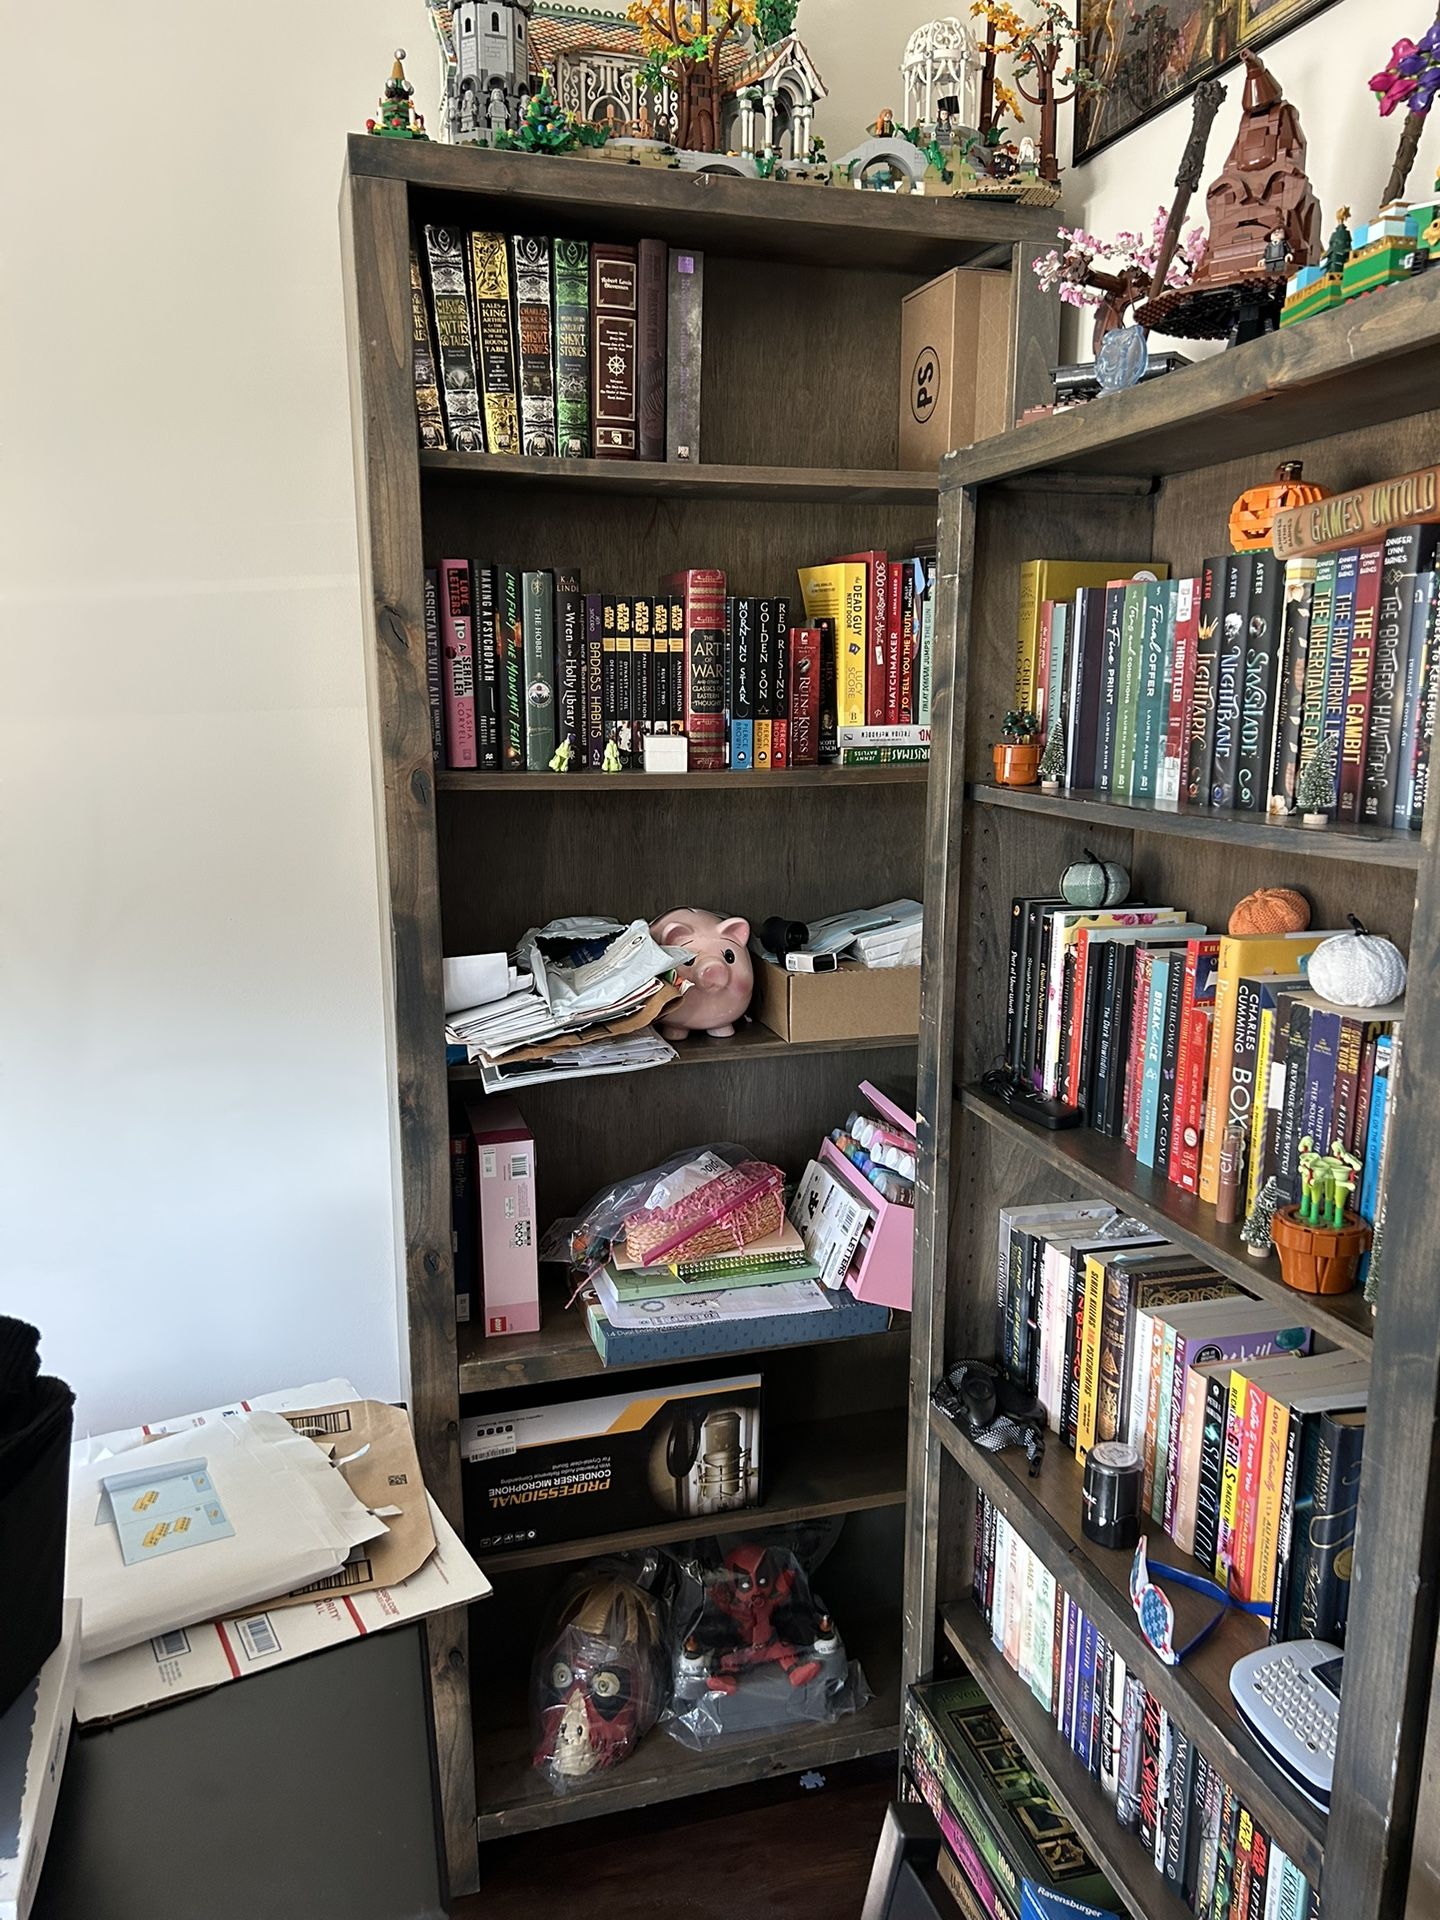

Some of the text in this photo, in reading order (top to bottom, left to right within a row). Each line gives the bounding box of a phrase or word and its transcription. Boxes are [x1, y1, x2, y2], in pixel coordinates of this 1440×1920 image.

[482, 309, 506, 317] KING
[522, 331, 548, 343] SHORT
[522, 345, 549, 354] STORIES
[560, 334, 585, 346] SHORT
[560, 347, 586, 357] STORIES
[917, 362, 933, 408] PS
[1311, 494, 1362, 543] GAMES
[1370, 472, 1435, 526] UNTOLD
[448, 569, 460, 615] LETTERS
[460, 579, 469, 605] LOVE
[482, 569, 492, 606] MAKING
[1204, 568, 1213, 600] ASTER
[1229, 567, 1238, 598] ASTER
[1254, 562, 1264, 594] ASTER
[852, 585, 862, 636] DEAD GUY
[903, 611, 911, 637] TRUTH
[483, 621, 494, 681] PSYCHOPATH
[694, 642, 722, 657] ART
[739, 601, 751, 704] MORNING STAR
[759, 602, 770, 699] GOLDEN SON
[1106, 626, 1120, 664] Fine
[1147, 604, 1164, 697] Final OFFER
[1326, 592, 1353, 714] THE HAWTHORNE
[452, 660, 464, 696] KILLER
[463, 656, 472, 693] SERIAL
[692, 663, 723, 678] WAR
[776, 640, 785, 699] RISING
[889, 633, 897, 708] MATCHMAKER
[1106, 669, 1115, 705] PRINT
[1172, 638, 1187, 703] THROTTLED
[1343, 607, 1374, 765] THE FINAL GAMBIT
[590, 642, 602, 738] BADASS HABITS
[902, 698, 909, 709] TO
[1215, 646, 1240, 757] NIGHTBANE
[457, 702, 465, 745] CORYELL
[1184, 698, 1192, 744] LAUREN
[1413, 763, 1425, 809] BAYLISS
[1077, 939, 1085, 987] ADULTING
[1106, 947, 1115, 991] CAMERON
[1185, 967, 1196, 976] 7
[1187, 950, 1195, 965] THE
[1185, 976, 1193, 1001] HABITS
[1060, 969, 1071, 1061] WUTHERING HEIGHTS
[1102, 1020, 1110, 1037] Dark
[1148, 991, 1162, 1062] BREAK ICE
[1166, 961, 1181, 1058] WHISTLEBLOWER
[1183, 1004, 1191, 1016] OF
[1234, 985, 1249, 1054] CUMMING
[1245, 994, 1259, 1051] CHARLES
[1181, 1017, 1190, 1044] HIGHLY
[1099, 1040, 1109, 1078] Unwinding
[1179, 1045, 1187, 1082] EFFECTIVE
[1228, 1067, 1252, 1129] BOX
[1308, 1080, 1319, 1130] THE SOUL
[1374, 1096, 1383, 1117] HOUSE
[1157, 1093, 1170, 1165] KAY COVE
[1316, 1106, 1325, 1141] NIGHT
[1372, 1119, 1379, 1130] ON
[1172, 1133, 1180, 1156] COVEY
[1369, 1145, 1377, 1161] CLIFF
[837, 1237, 860, 1278] LETTERS
[1091, 1271, 1099, 1296] SERIAL
[1089, 1298, 1098, 1328] KILLERS
[1084, 1344, 1095, 1398] PSYCHOPATHS
[1225, 1387, 1239, 1481] RECKLESS GIRLS
[488, 1469, 611, 1496] CONDENSER MICROPHONE
[1283, 1432, 1296, 1505] The POWER
[1319, 1446, 1331, 1511] ANTHONY
[489, 1478, 610, 1508] PROFESSIONAL
[1193, 1440, 1220, 1569] SALVATION
[1260, 1519, 1272, 1594] ALI HAZELWOOD
[1067, 1618, 1076, 1646] PRIDE
[1080, 1681, 1090, 1735] ANA HUANG
[1199, 1843, 1212, 1910] LISA JEWELL
[1037, 1886, 1103, 1918] Ravensburger
